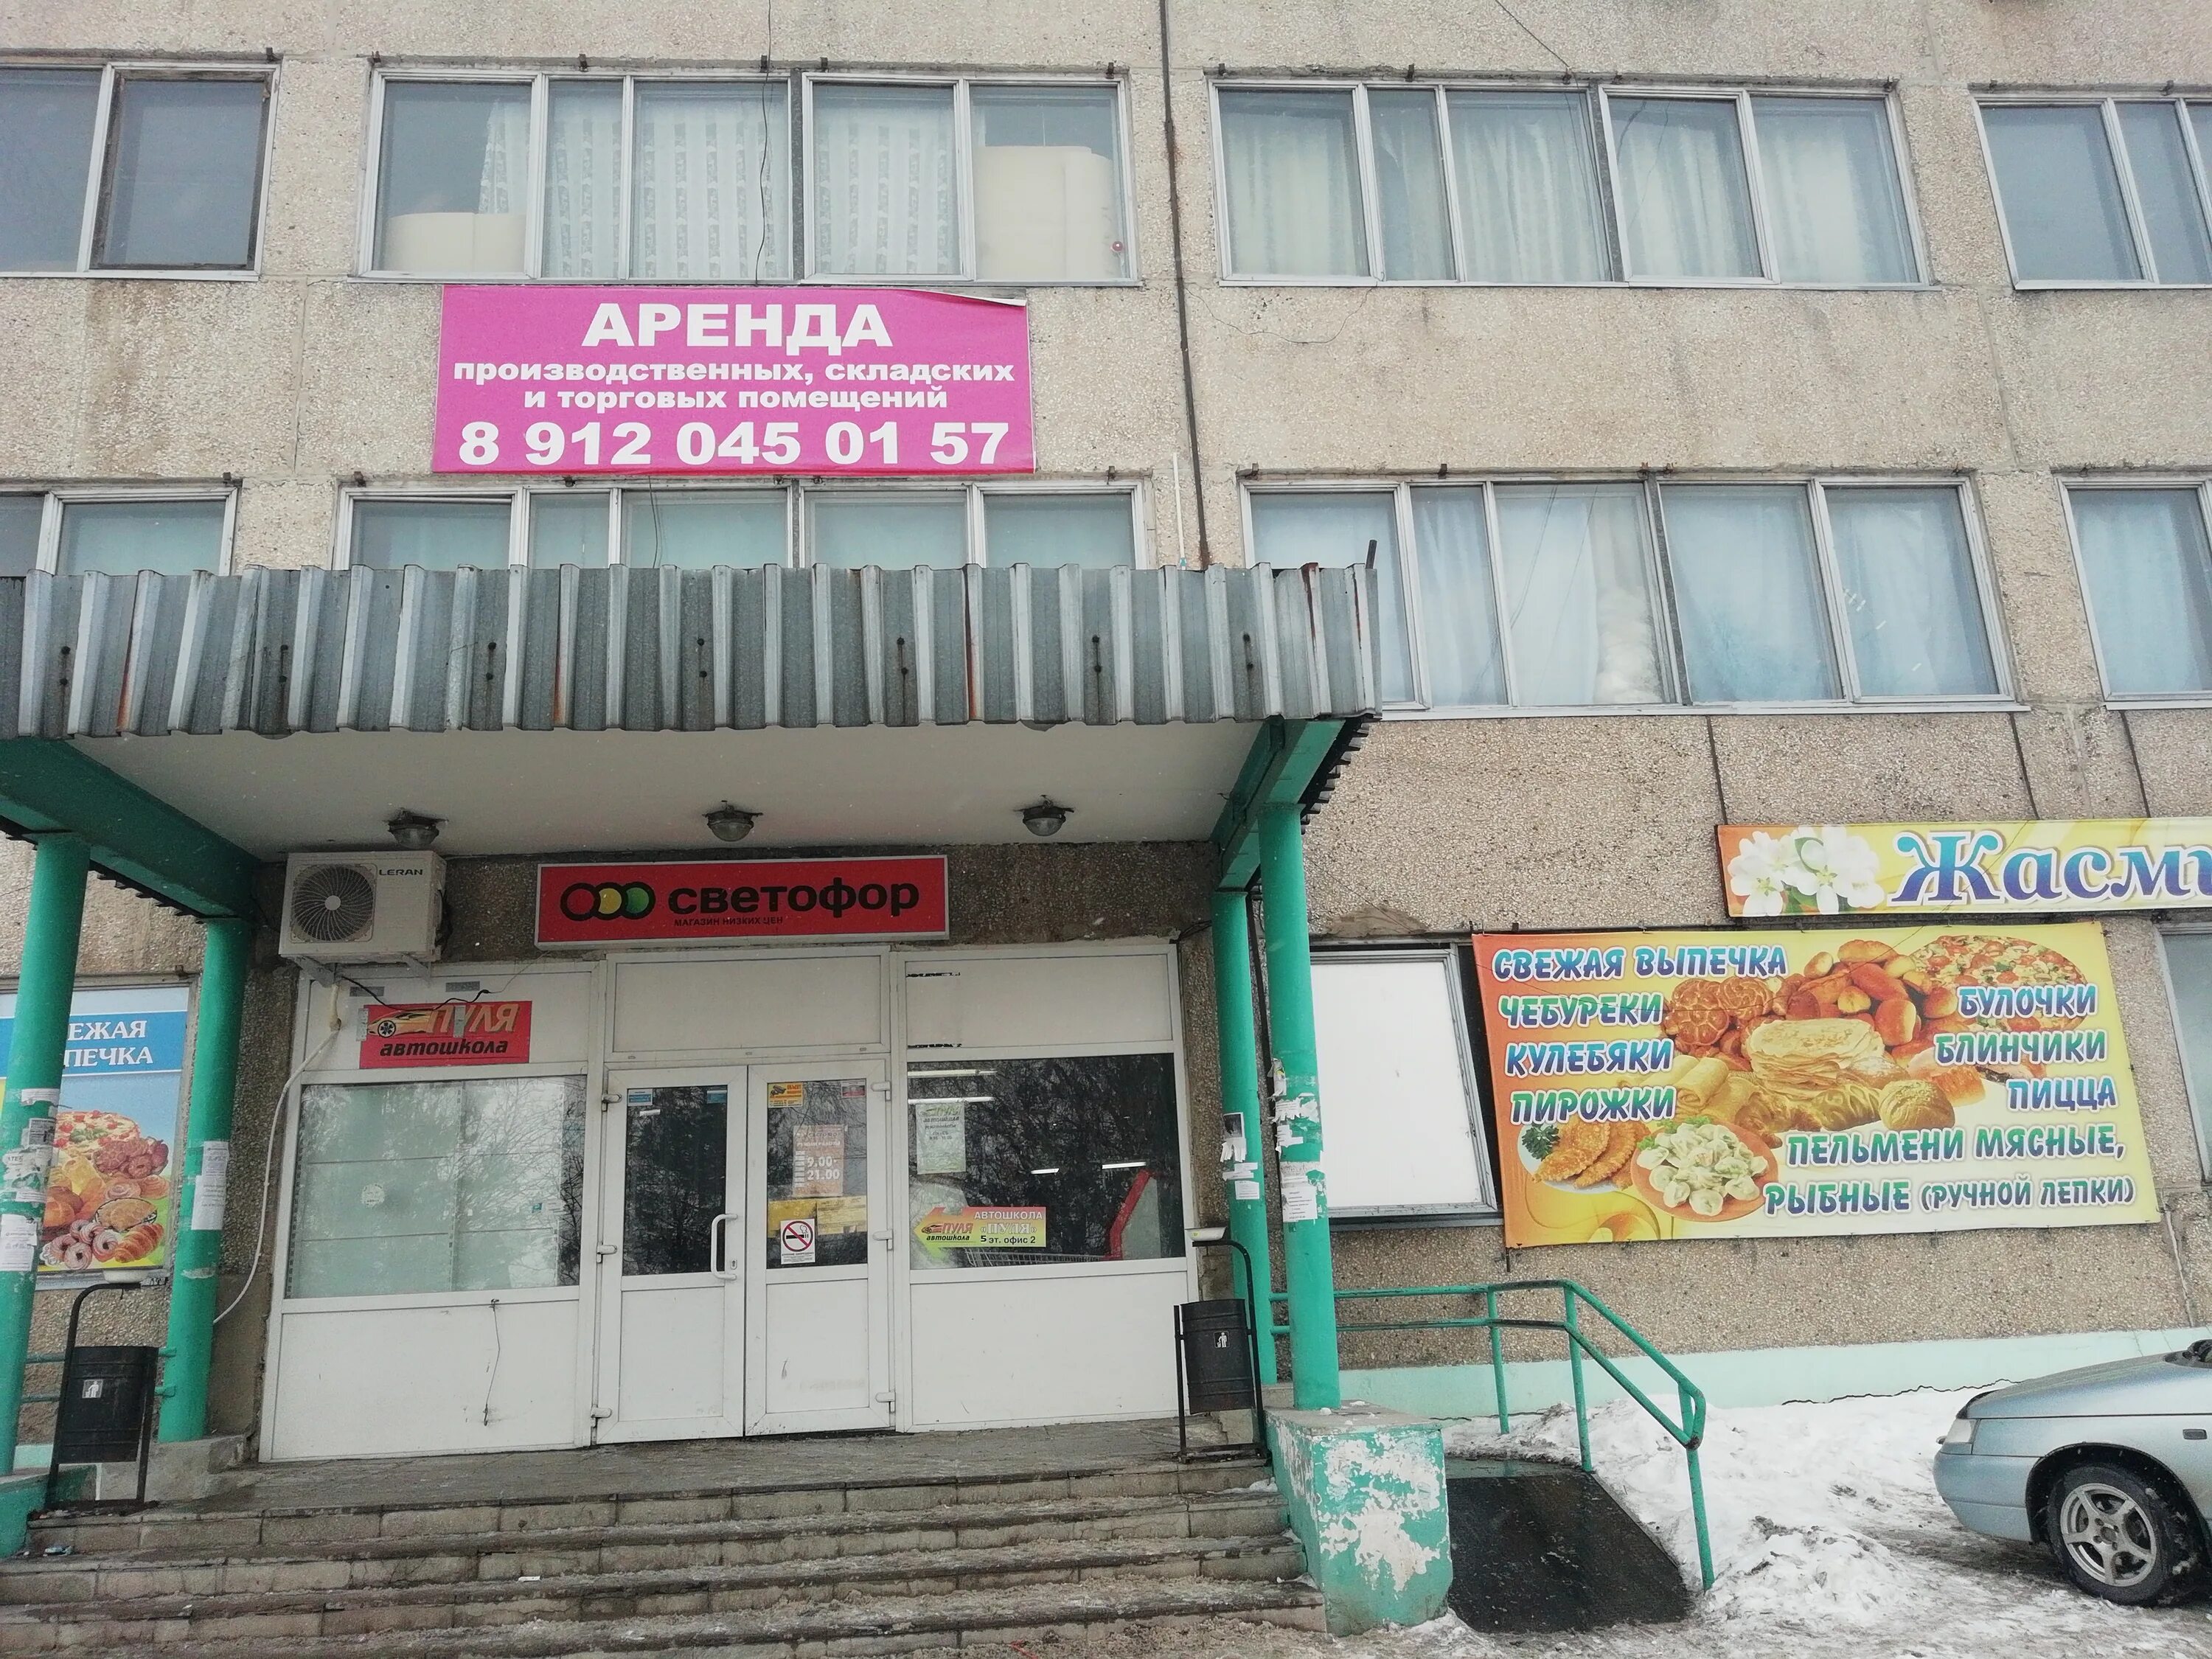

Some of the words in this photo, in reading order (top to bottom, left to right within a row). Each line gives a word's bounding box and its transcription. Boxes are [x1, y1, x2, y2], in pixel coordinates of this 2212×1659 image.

[581, 303, 894, 356] АРЕНДА
[453, 362, 814, 386] производственных,
[824, 364, 1015, 386] складских
[524, 390, 546, 408] и
[557, 390, 727, 414] торговых
[738, 385, 948, 412] помещений
[458, 420, 500, 466] 8
[524, 420, 652, 466] 912
[675, 421, 801, 465] 045
[824, 421, 899, 465] 01
[929, 422, 1009, 466] 57
[668, 877, 919, 918] светофор
[673, 918, 720, 927] МАГАЗИН
[722, 917, 761, 925] НИЗКИХ
[762, 916, 784, 925] ЦЕН
[1494, 948, 1625, 979] СВЕЖАЯ
[1635, 947, 1788, 977] ВЫПЕЧКА
[1500, 993, 1663, 1028] ЧЕБУРЕКИ
[1958, 984, 2097, 1018] БУЛОЧКИ
[67, 1020, 147, 1041] ЕЖАЯ
[63, 1046, 153, 1067] ПЕЧКА
[379, 1039, 509, 1057] автошкола
[1506, 1040, 1674, 1077] КУЛЕБЯКИ
[1935, 1030, 2107, 1064] БЛИНЧИКИ
[1512, 1088, 1677, 1124] ПИРОЖКИ
[2007, 1077, 2118, 1111] ПИЦЦА
[1787, 1127, 1964, 1166] ПЕЛЬМЕНИ
[1976, 1124, 2126, 1161] МЯСНЫЕ,
[807, 1169, 841, 1180] 21.00
[1764, 1180, 1911, 1215] РЫБНЫЕ
[1921, 1175, 2032, 1211] (РУЧНОЙ
[2039, 1178, 2135, 1207] ЛЕПКИ)
[942, 1222, 974, 1234] ПУЛЯ
[974, 1211, 1043, 1220] АВТОШКОЛА
[980, 1222, 1037, 1234] «ПУЛЯ»
[1004, 1237, 1029, 1245] офис
[1030, 1236, 1036, 1244] 2
